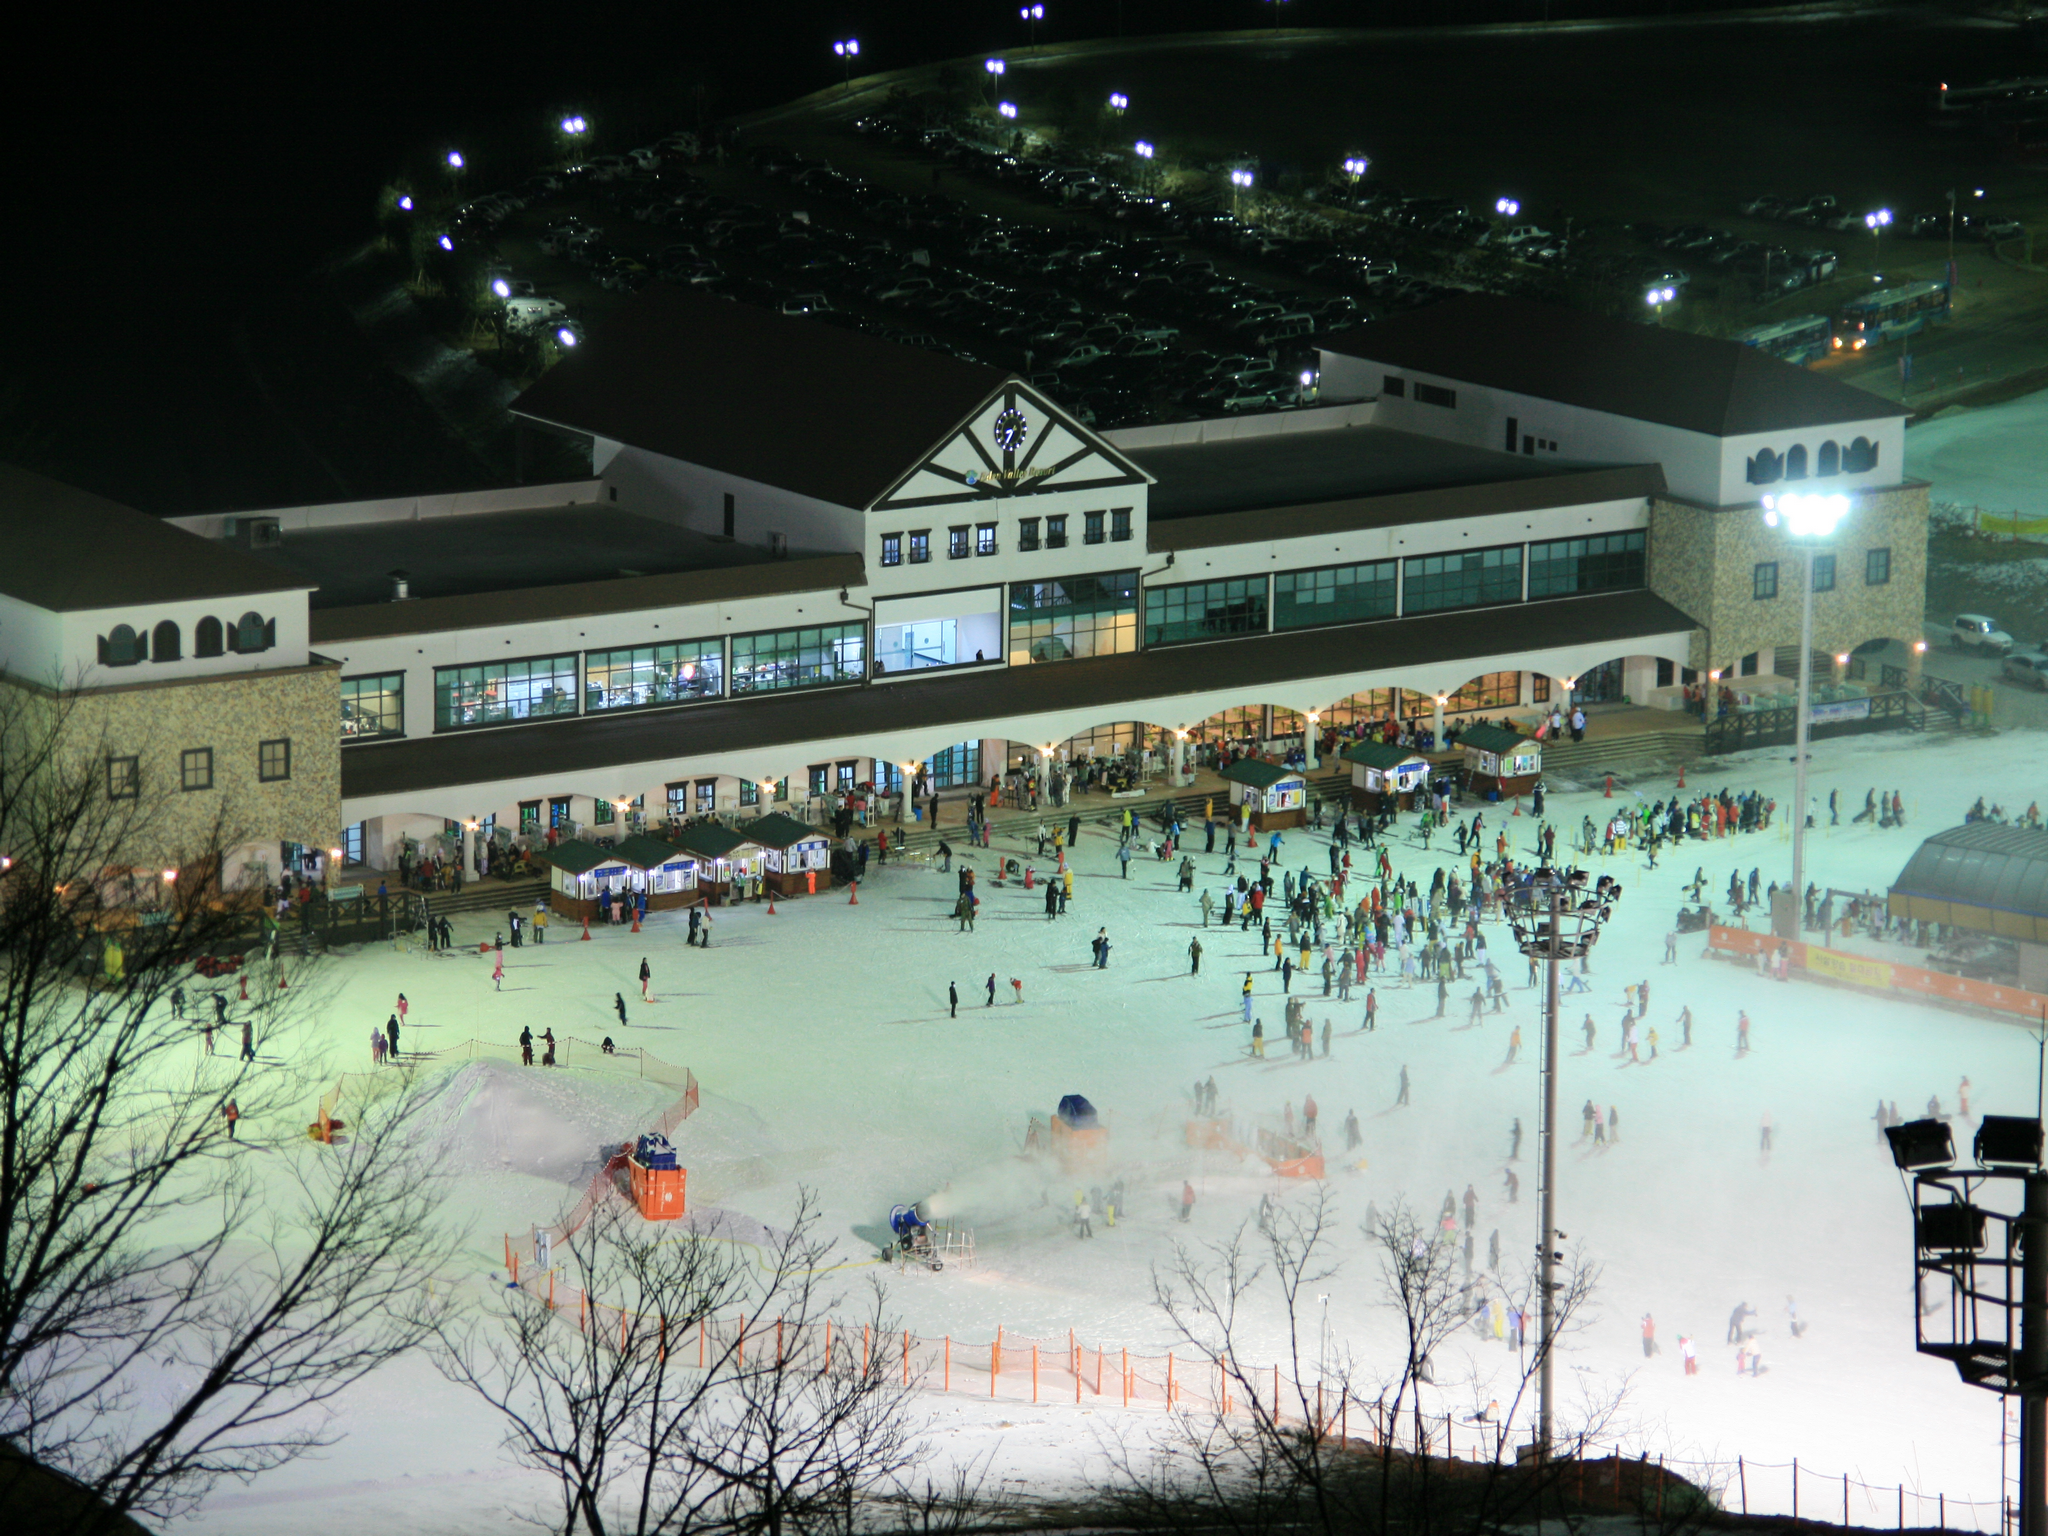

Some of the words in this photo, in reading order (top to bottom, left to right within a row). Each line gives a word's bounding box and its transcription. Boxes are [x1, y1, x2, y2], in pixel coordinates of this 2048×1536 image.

[980, 470, 1002, 482] Eden
[1003, 468, 1027, 480] Valley
[1029, 466, 1056, 477] Resort
